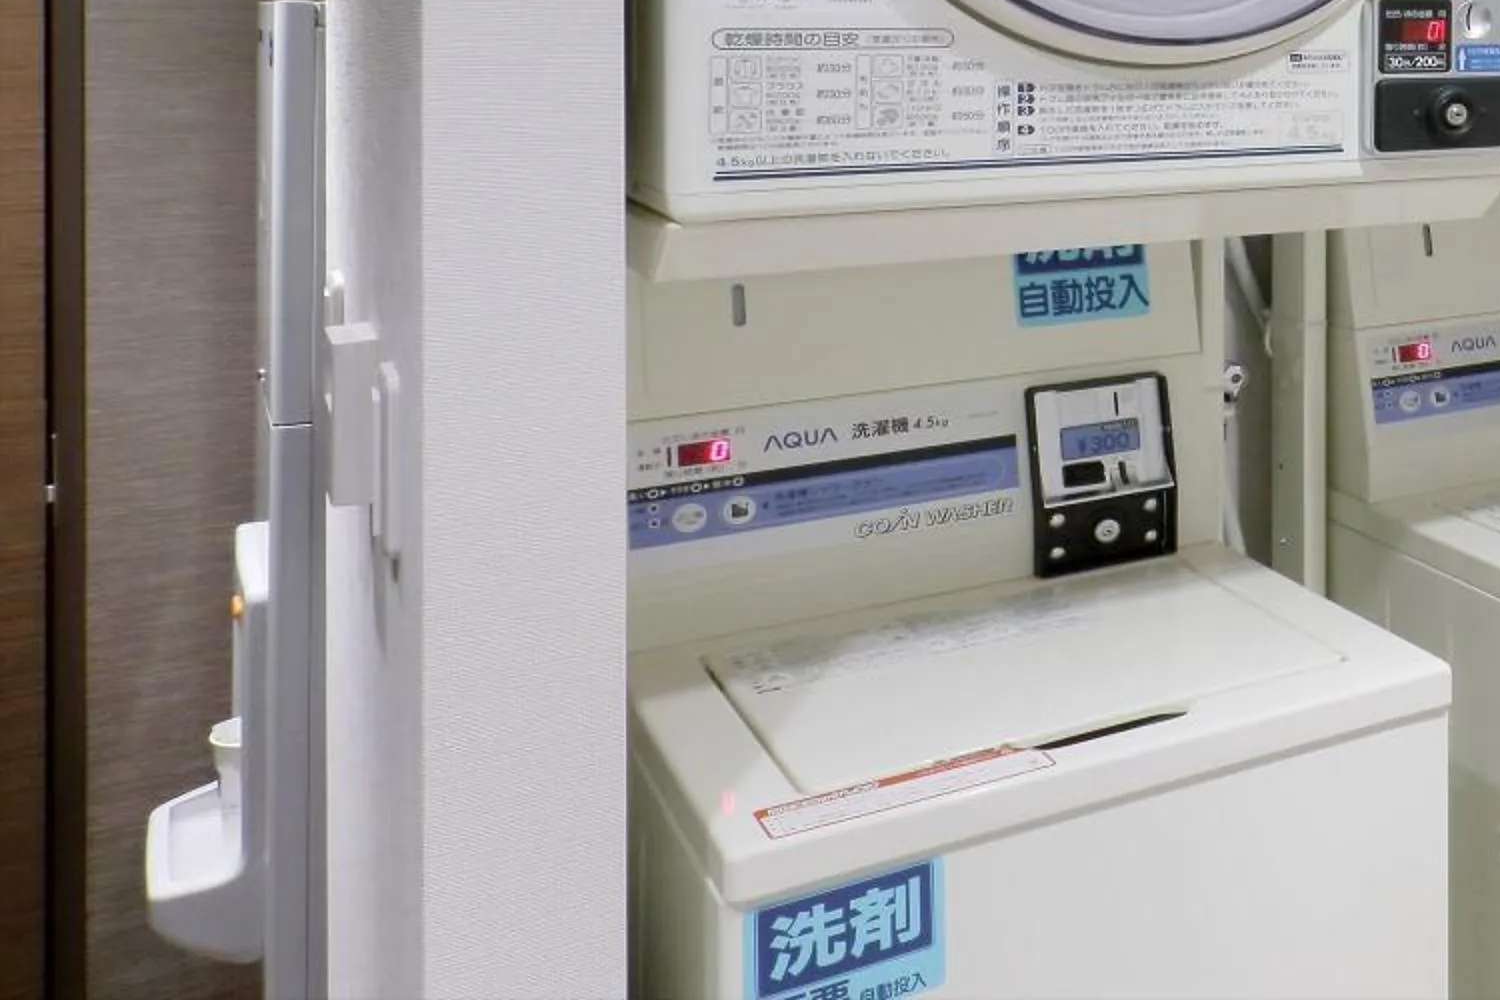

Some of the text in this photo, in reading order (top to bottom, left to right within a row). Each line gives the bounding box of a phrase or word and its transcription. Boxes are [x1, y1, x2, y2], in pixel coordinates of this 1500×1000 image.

[1019, 273, 1150, 318] 自動投入
[1451, 335, 1496, 353] AQUA
[711, 441, 729, 461] 0
[763, 427, 838, 454] AQUA
[851, 416, 909, 441] 洗濯機
[927, 497, 1014, 527] WASHER
[769, 874, 922, 982] 洗剤
